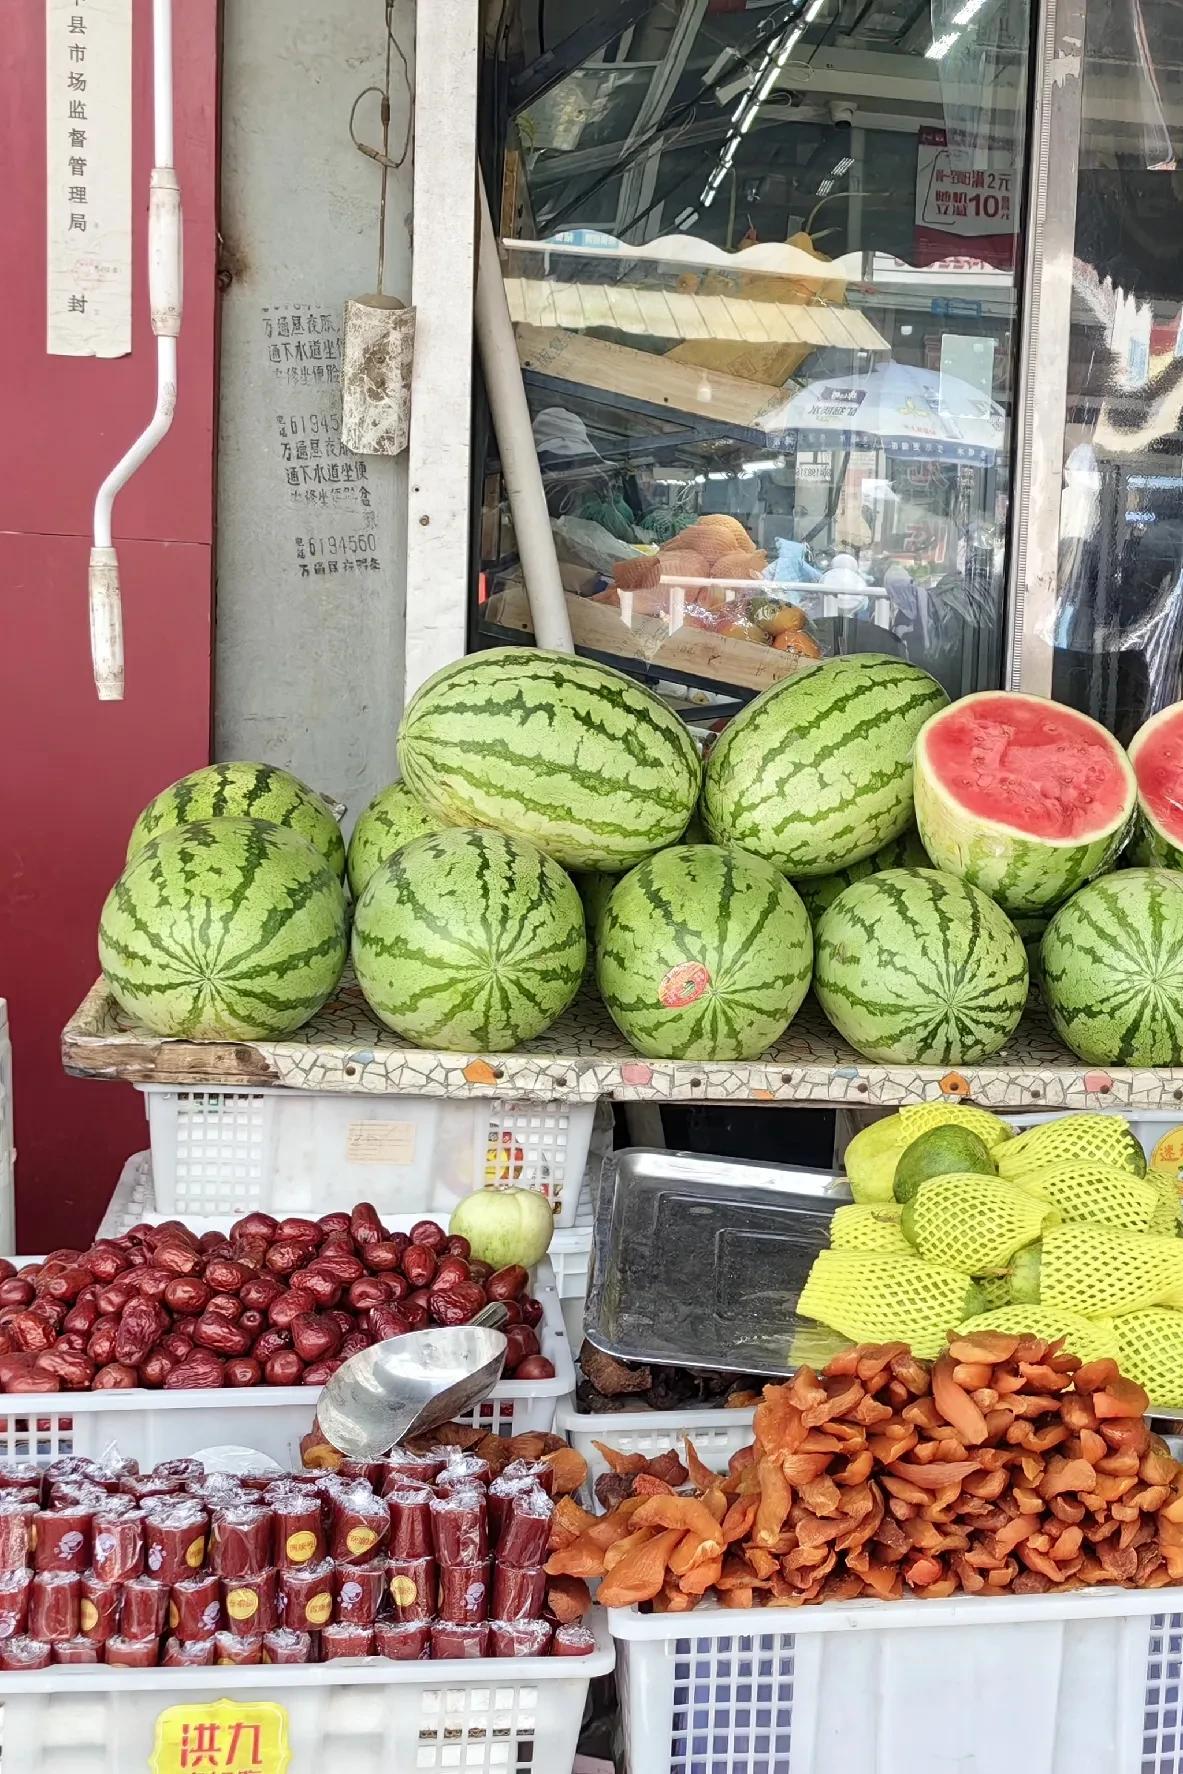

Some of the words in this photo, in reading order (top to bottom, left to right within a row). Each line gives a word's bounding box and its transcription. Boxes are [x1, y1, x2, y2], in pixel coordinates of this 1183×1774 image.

[67, 0, 88, 233] 县市场监督管理局
[67, 295, 89, 315] 封
[290, 413, 343, 434] 61945
[308, 533, 376, 558] 6194560
[180, 1722, 263, 1768] 洪九
